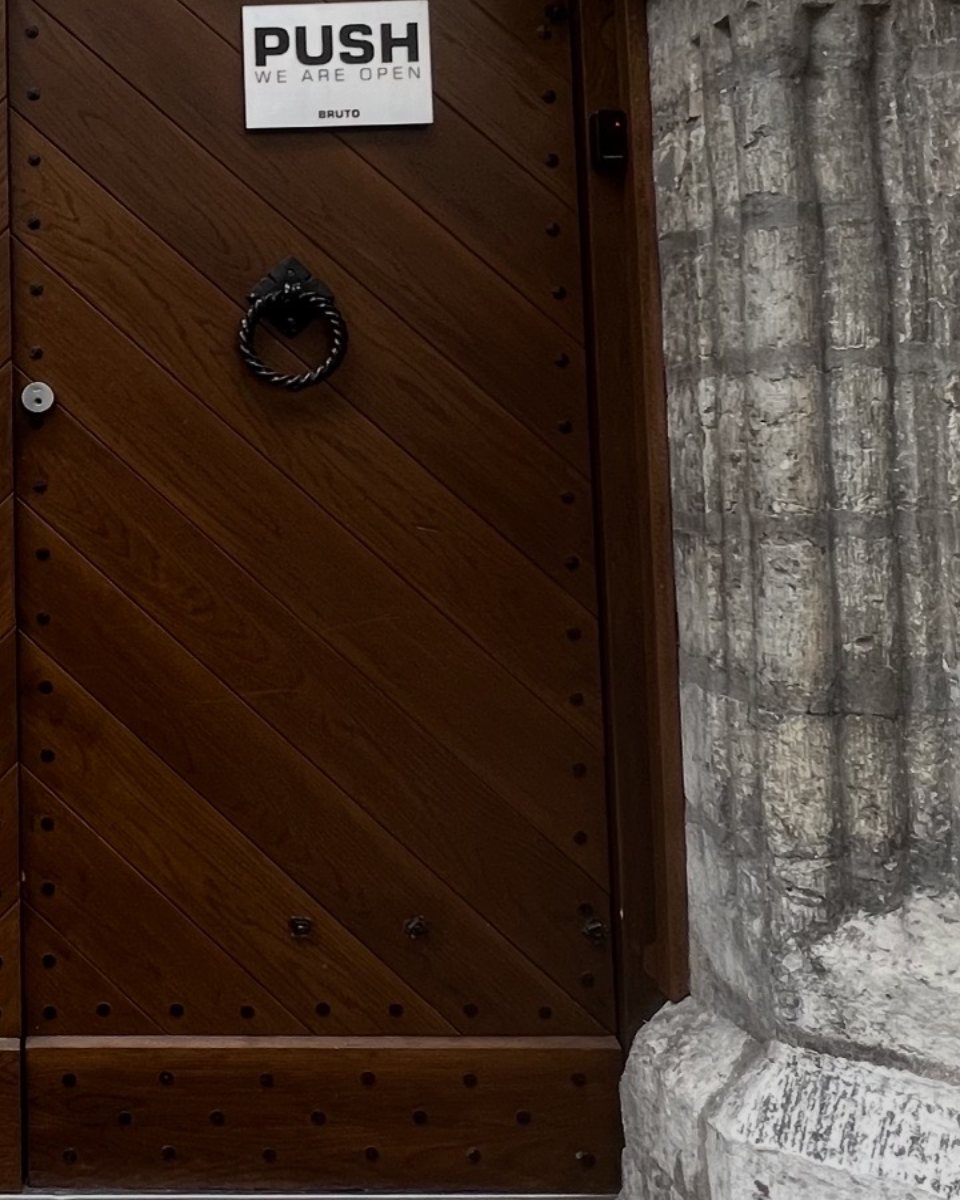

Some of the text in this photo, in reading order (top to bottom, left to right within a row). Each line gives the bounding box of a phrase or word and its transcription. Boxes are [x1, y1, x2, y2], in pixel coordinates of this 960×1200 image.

[254, 22, 419, 67] PUSH
[254, 66, 421, 84] WE ARE OPEN
[318, 108, 361, 119] BRUTO
